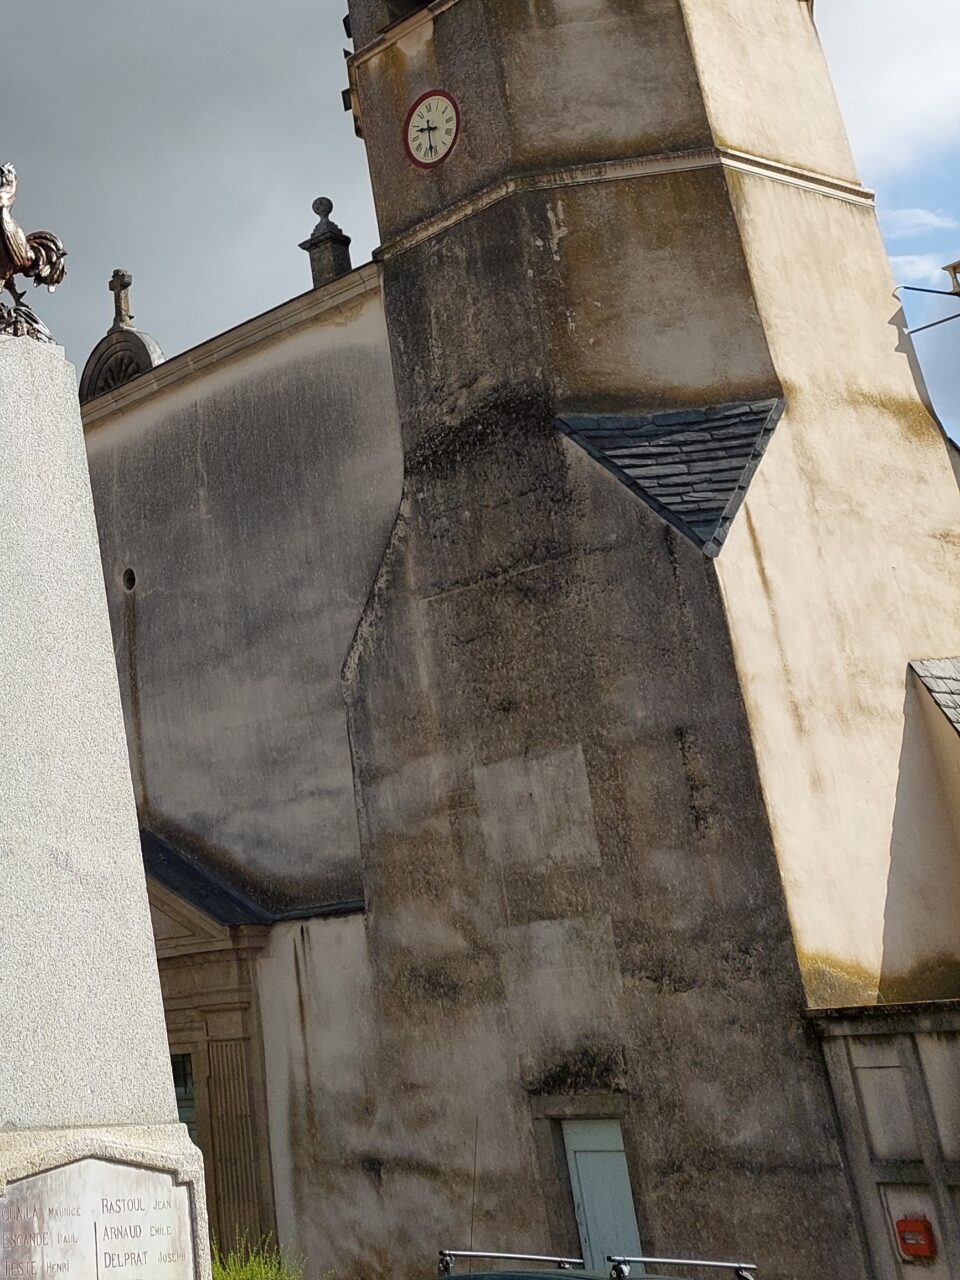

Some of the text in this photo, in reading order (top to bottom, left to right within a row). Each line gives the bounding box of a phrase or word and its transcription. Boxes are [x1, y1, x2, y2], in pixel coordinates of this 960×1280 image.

[48, 1205, 81, 1218] MAURICE
[101, 1197, 172, 1214] RASTOUL JEAN
[2, 1232, 78, 1249] ESCANDE PAUL
[102, 1223, 172, 1241] ARNAUD EMILE
[4, 1258, 70, 1277] TESTE HENRI
[103, 1251, 186, 1269] DELPRAT JOSEPH
